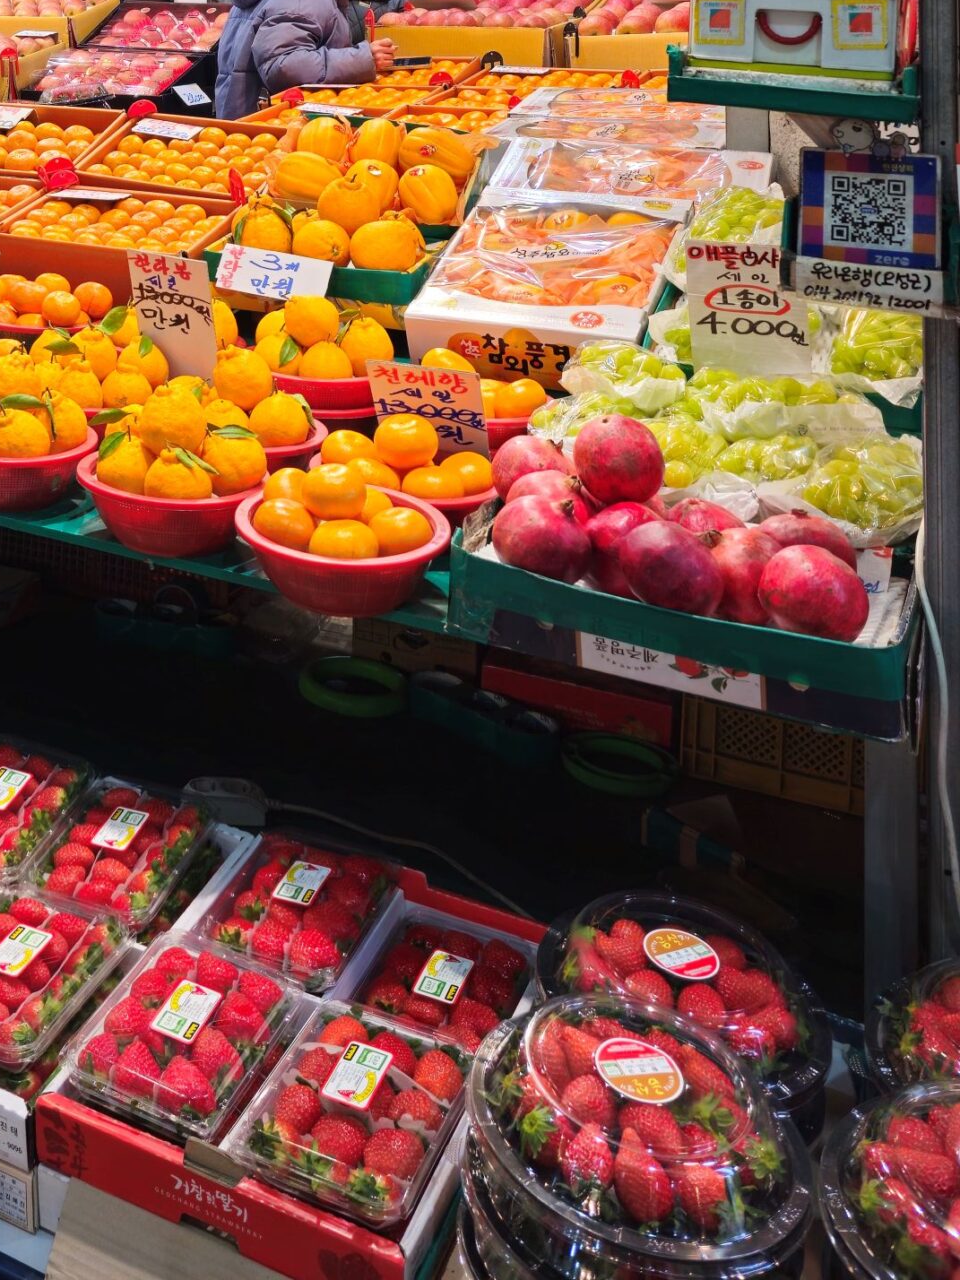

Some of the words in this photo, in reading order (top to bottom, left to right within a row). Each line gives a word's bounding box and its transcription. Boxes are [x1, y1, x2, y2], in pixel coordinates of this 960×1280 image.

[129, 253, 192, 280] 한라봉
[874, 253, 910, 267] zero
[250, 275, 294, 297] 만원
[141, 306, 190, 334] 만원
[374, 365, 469, 395] 천혜향
